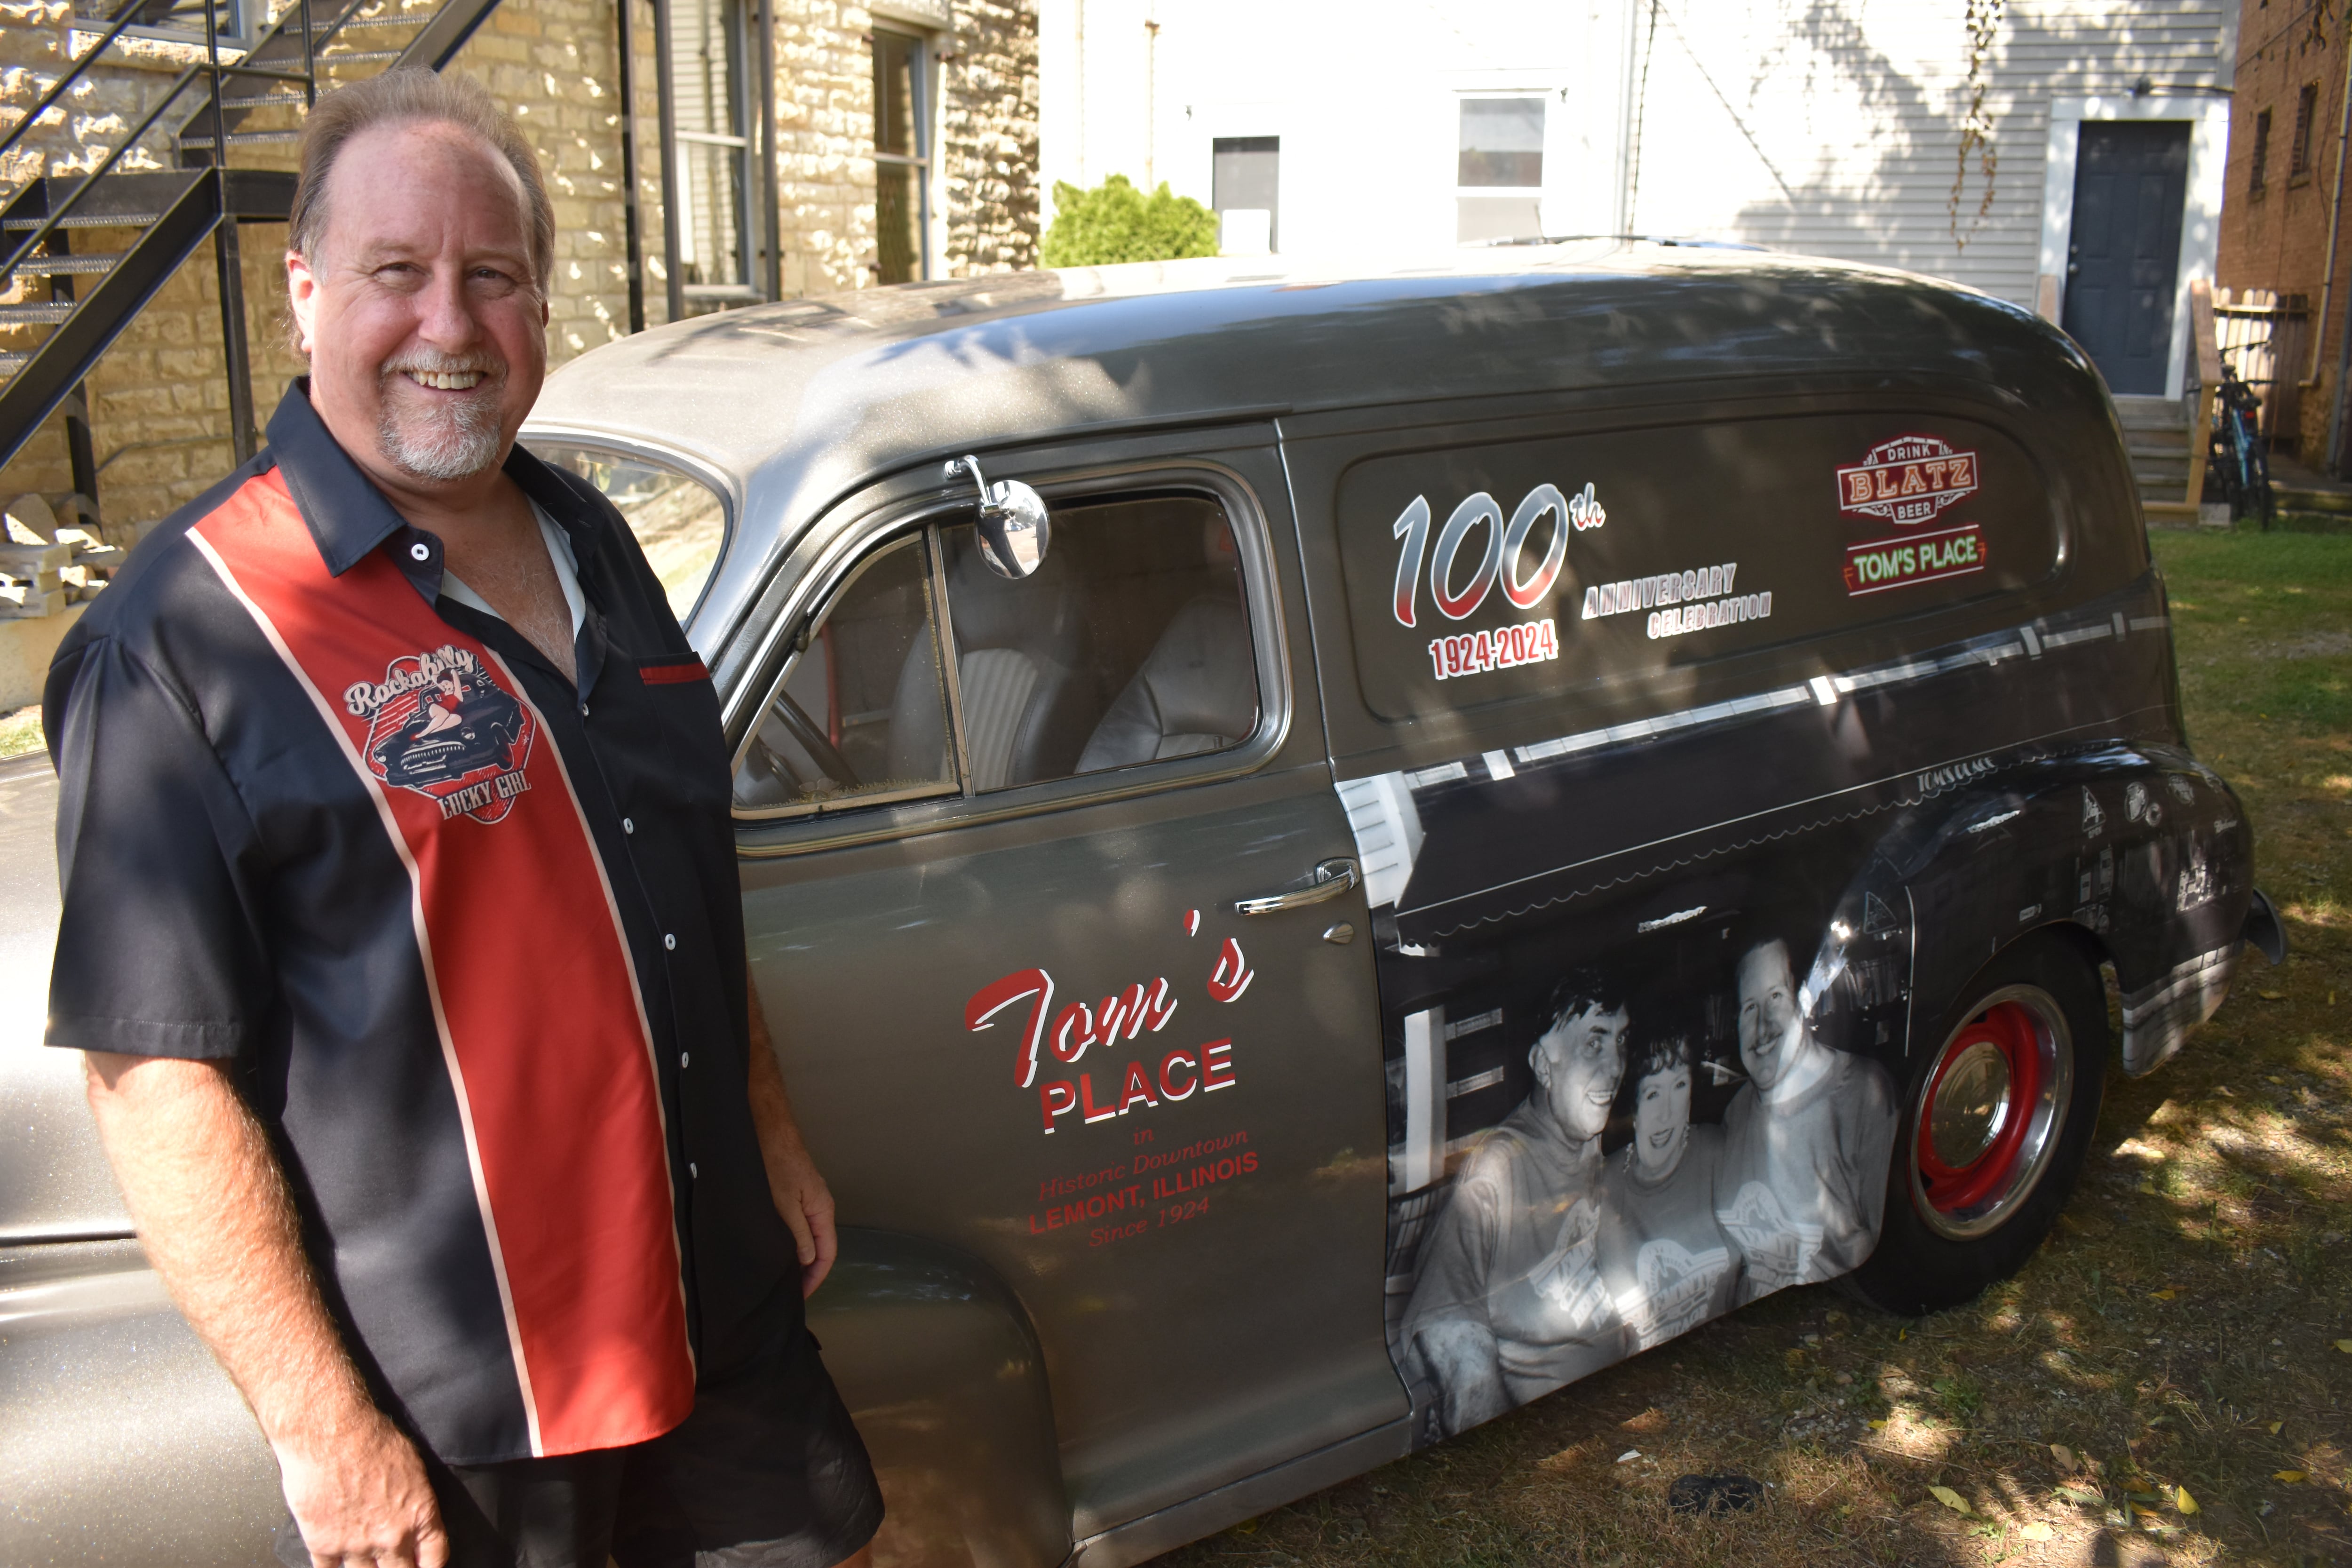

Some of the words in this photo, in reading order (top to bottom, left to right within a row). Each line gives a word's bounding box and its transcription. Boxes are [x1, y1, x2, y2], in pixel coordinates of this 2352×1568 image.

[1887, 445, 1931, 461] DRINK
[1849, 458, 1971, 503] BLATZ
[1897, 501, 1931, 519] BEER
[1393, 482, 1606, 628] 100th
[1853, 547, 1915, 583] TOM'S
[1919, 535, 1978, 572] PLACE
[1581, 563, 1738, 620] ANNIVERSARY
[1647, 591, 1772, 640] CELEBRATION
[1429, 618, 1559, 680] 1924-2024
[343, 645, 479, 716] Rockabilly
[437, 780, 493, 820] LUCKY
[495, 770, 532, 799] GIRL
[965, 909, 1254, 1088] Tom's
[1040, 1037, 1236, 1134] PLACE
[1133, 1127, 1155, 1146] in
[1029, 1185, 1146, 1235] LEMONT,
[1153, 1151, 1259, 1201] ILLINOIS
[1039, 1160, 1126, 1202] Historic
[1133, 1130, 1249, 1176] Downtown
[1089, 1218, 1148, 1248] Since
[1157, 1196, 1210, 1228] 1924
